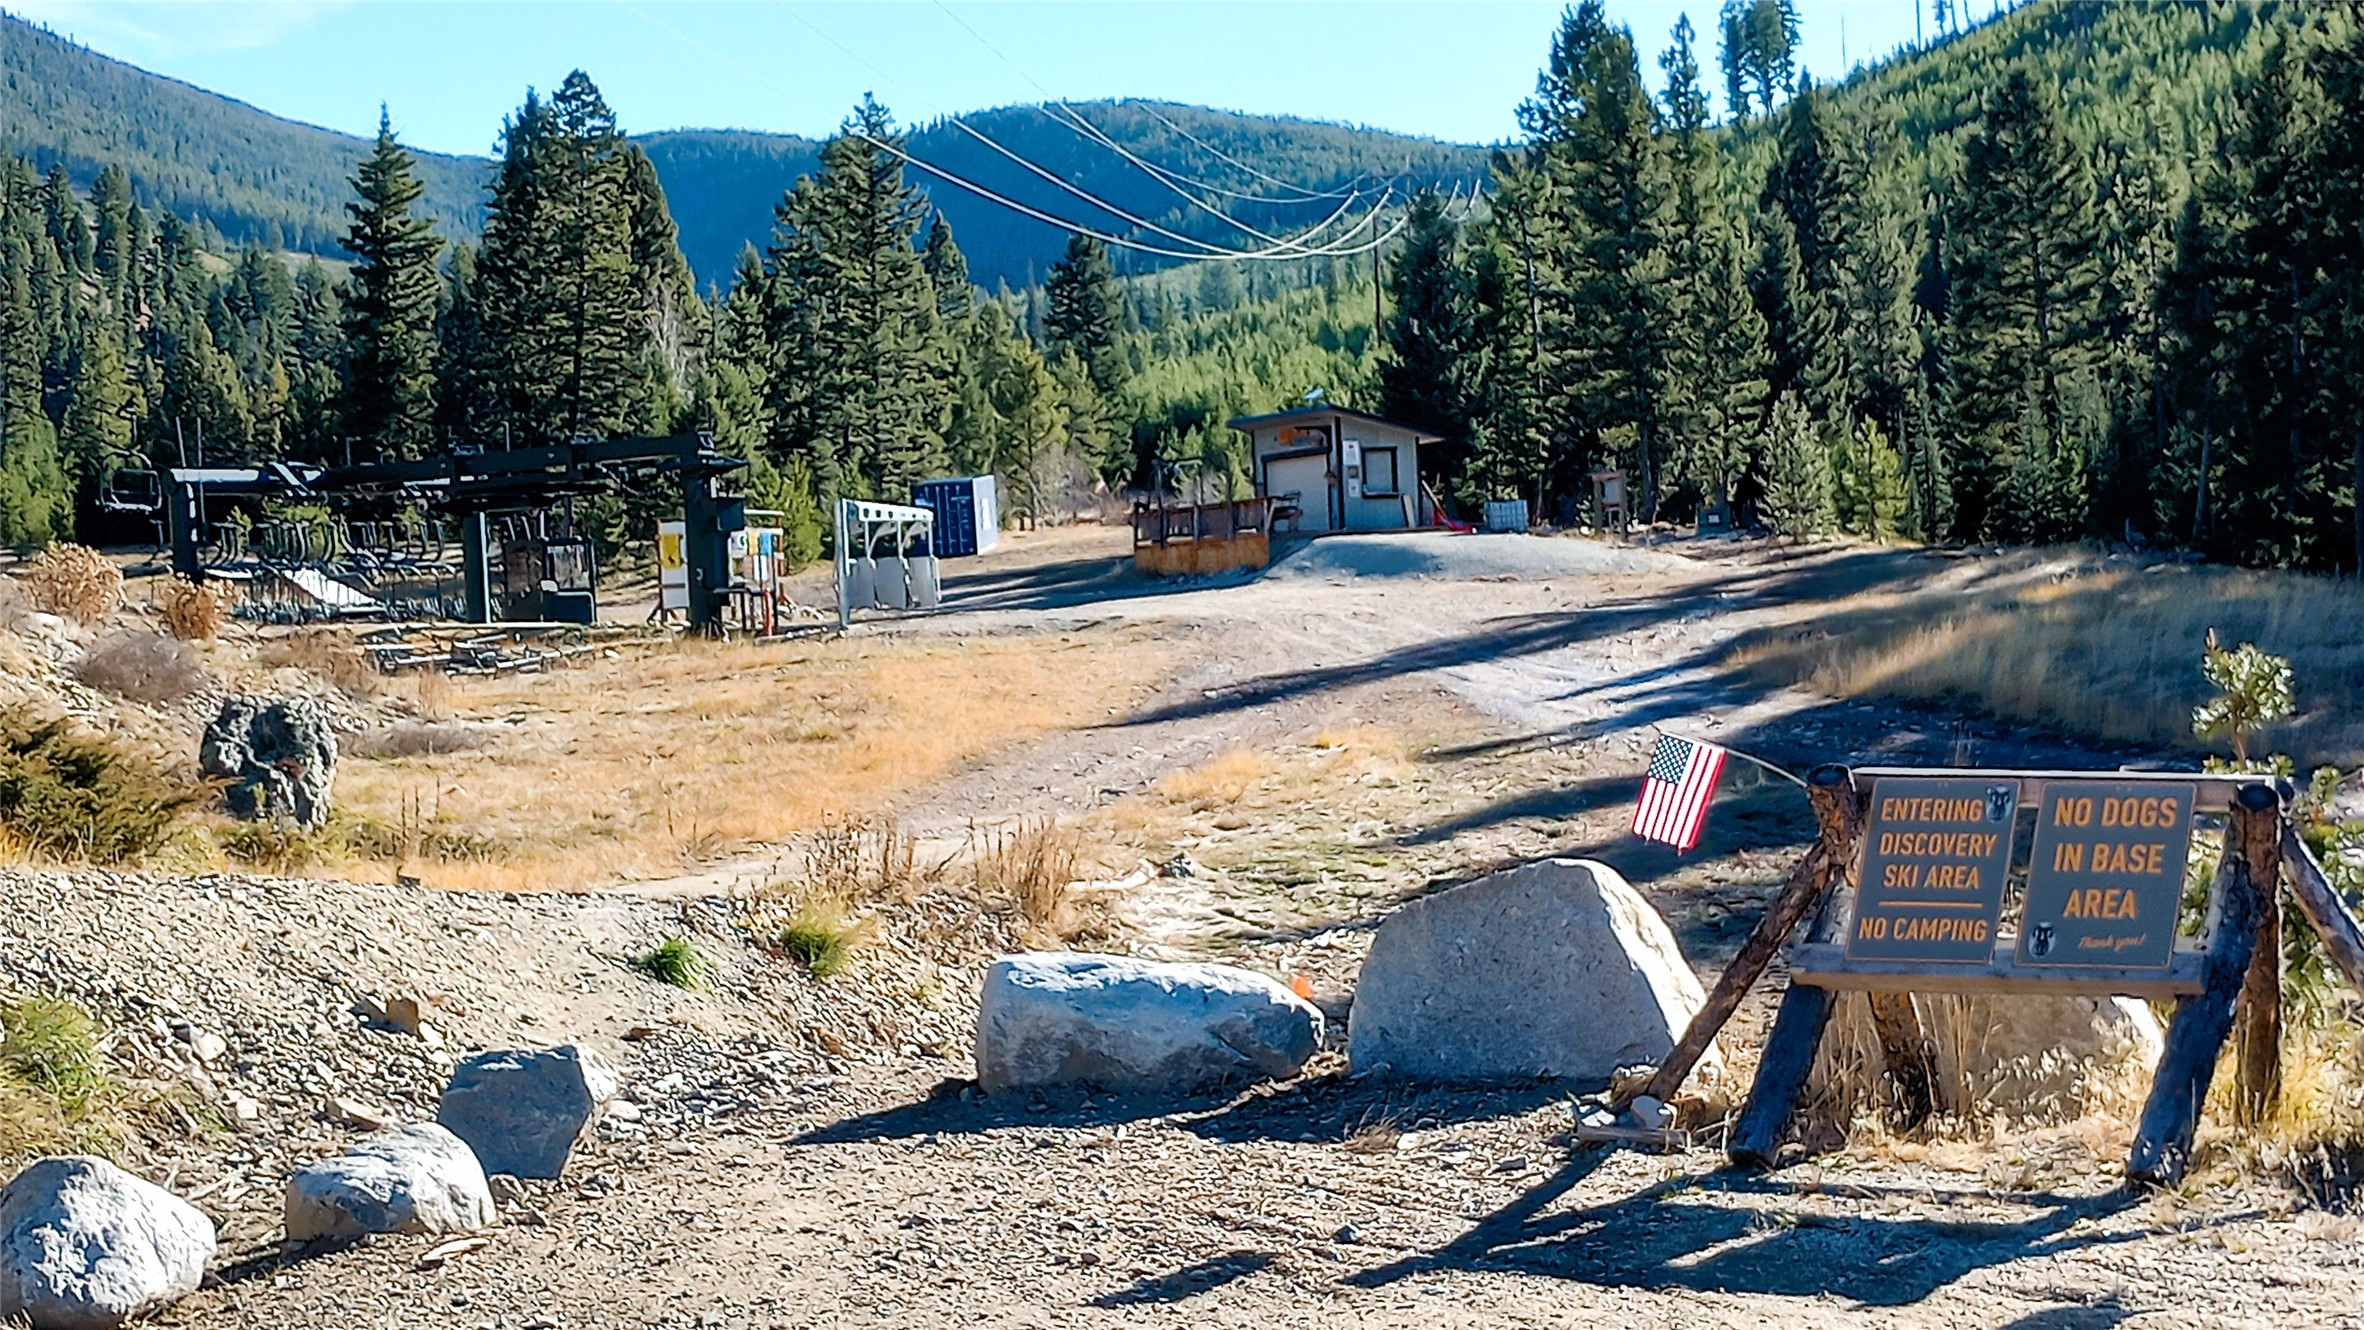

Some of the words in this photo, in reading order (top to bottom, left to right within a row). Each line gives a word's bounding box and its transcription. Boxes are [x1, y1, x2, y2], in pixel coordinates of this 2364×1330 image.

[1880, 798, 1983, 821] ENTERING
[2053, 797, 2092, 827] NO
[2101, 797, 2178, 828] DOGS
[1879, 832, 1998, 857] DISCOVERY
[2053, 843, 2083, 872] IN
[2091, 843, 2166, 873] BASE
[1883, 864, 1919, 888] SKI
[1923, 865, 1980, 890] AREA
[2062, 889, 2137, 919] AREA
[1858, 917, 1887, 939] NO
[1893, 917, 1988, 942] CAMPING
